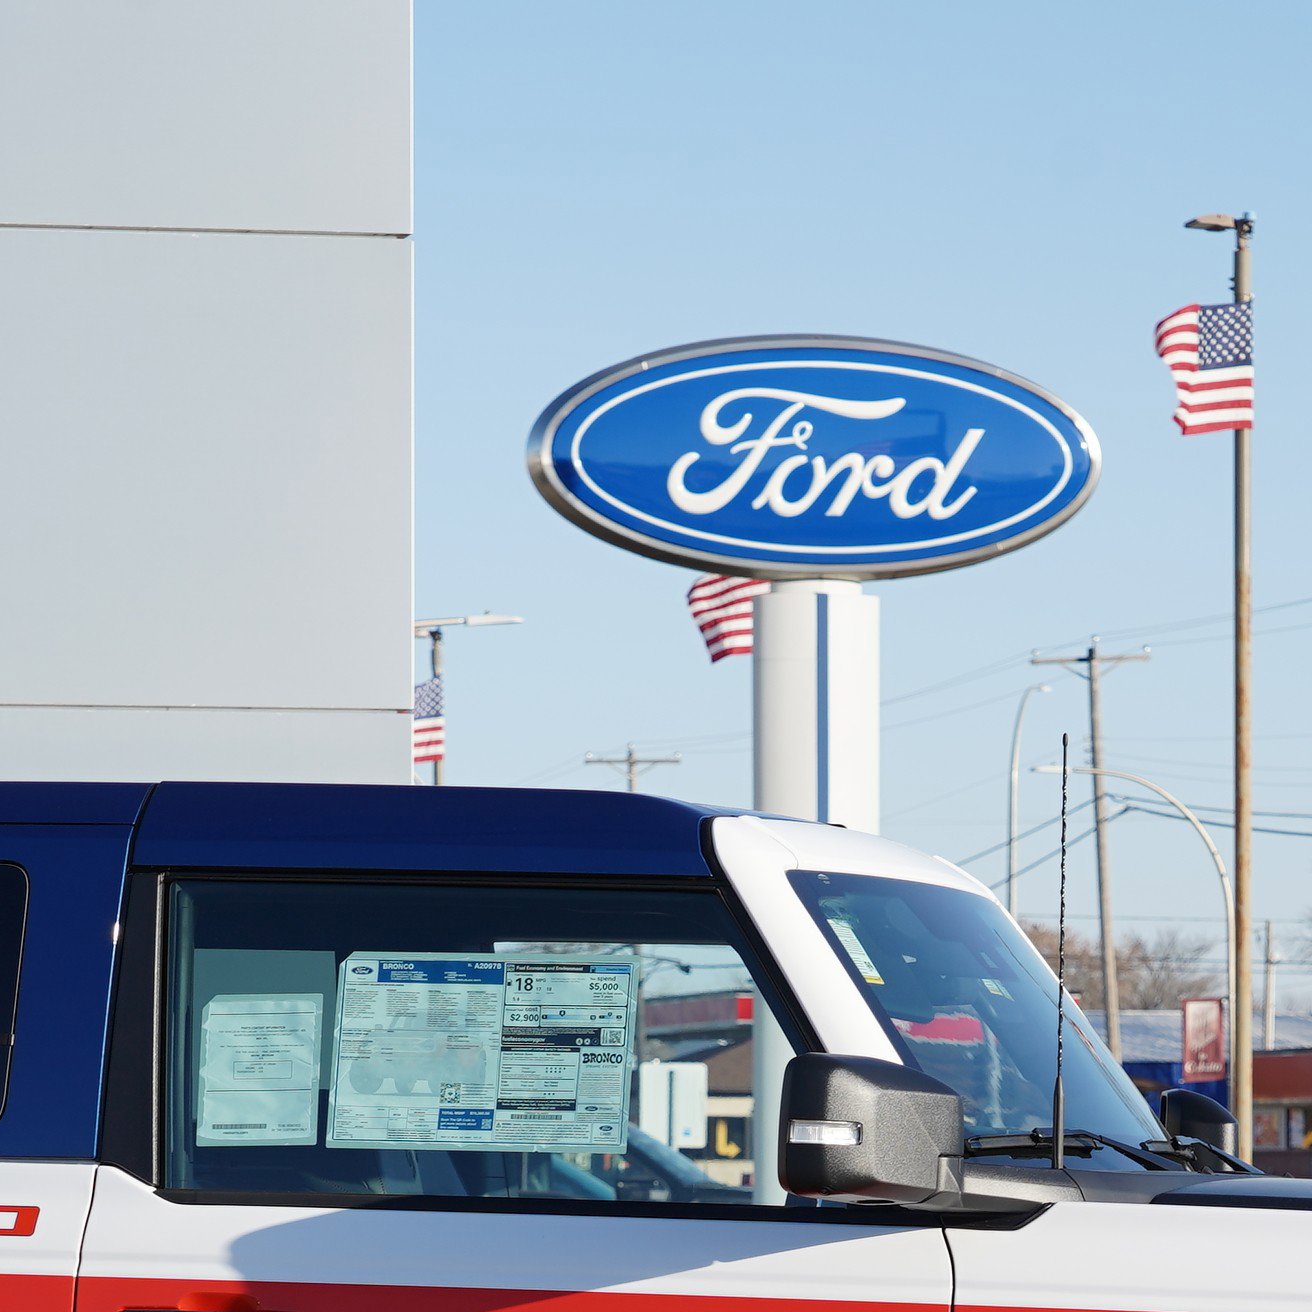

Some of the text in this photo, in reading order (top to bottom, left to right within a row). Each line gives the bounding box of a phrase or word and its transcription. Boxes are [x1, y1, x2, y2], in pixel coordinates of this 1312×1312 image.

[667, 386, 986, 520] Ford
[515, 977, 534, 991] 18
[589, 983, 619, 991] $5,000
[510, 1013, 539, 1022] $2,900
[582, 1053, 623, 1064] BRONCO
